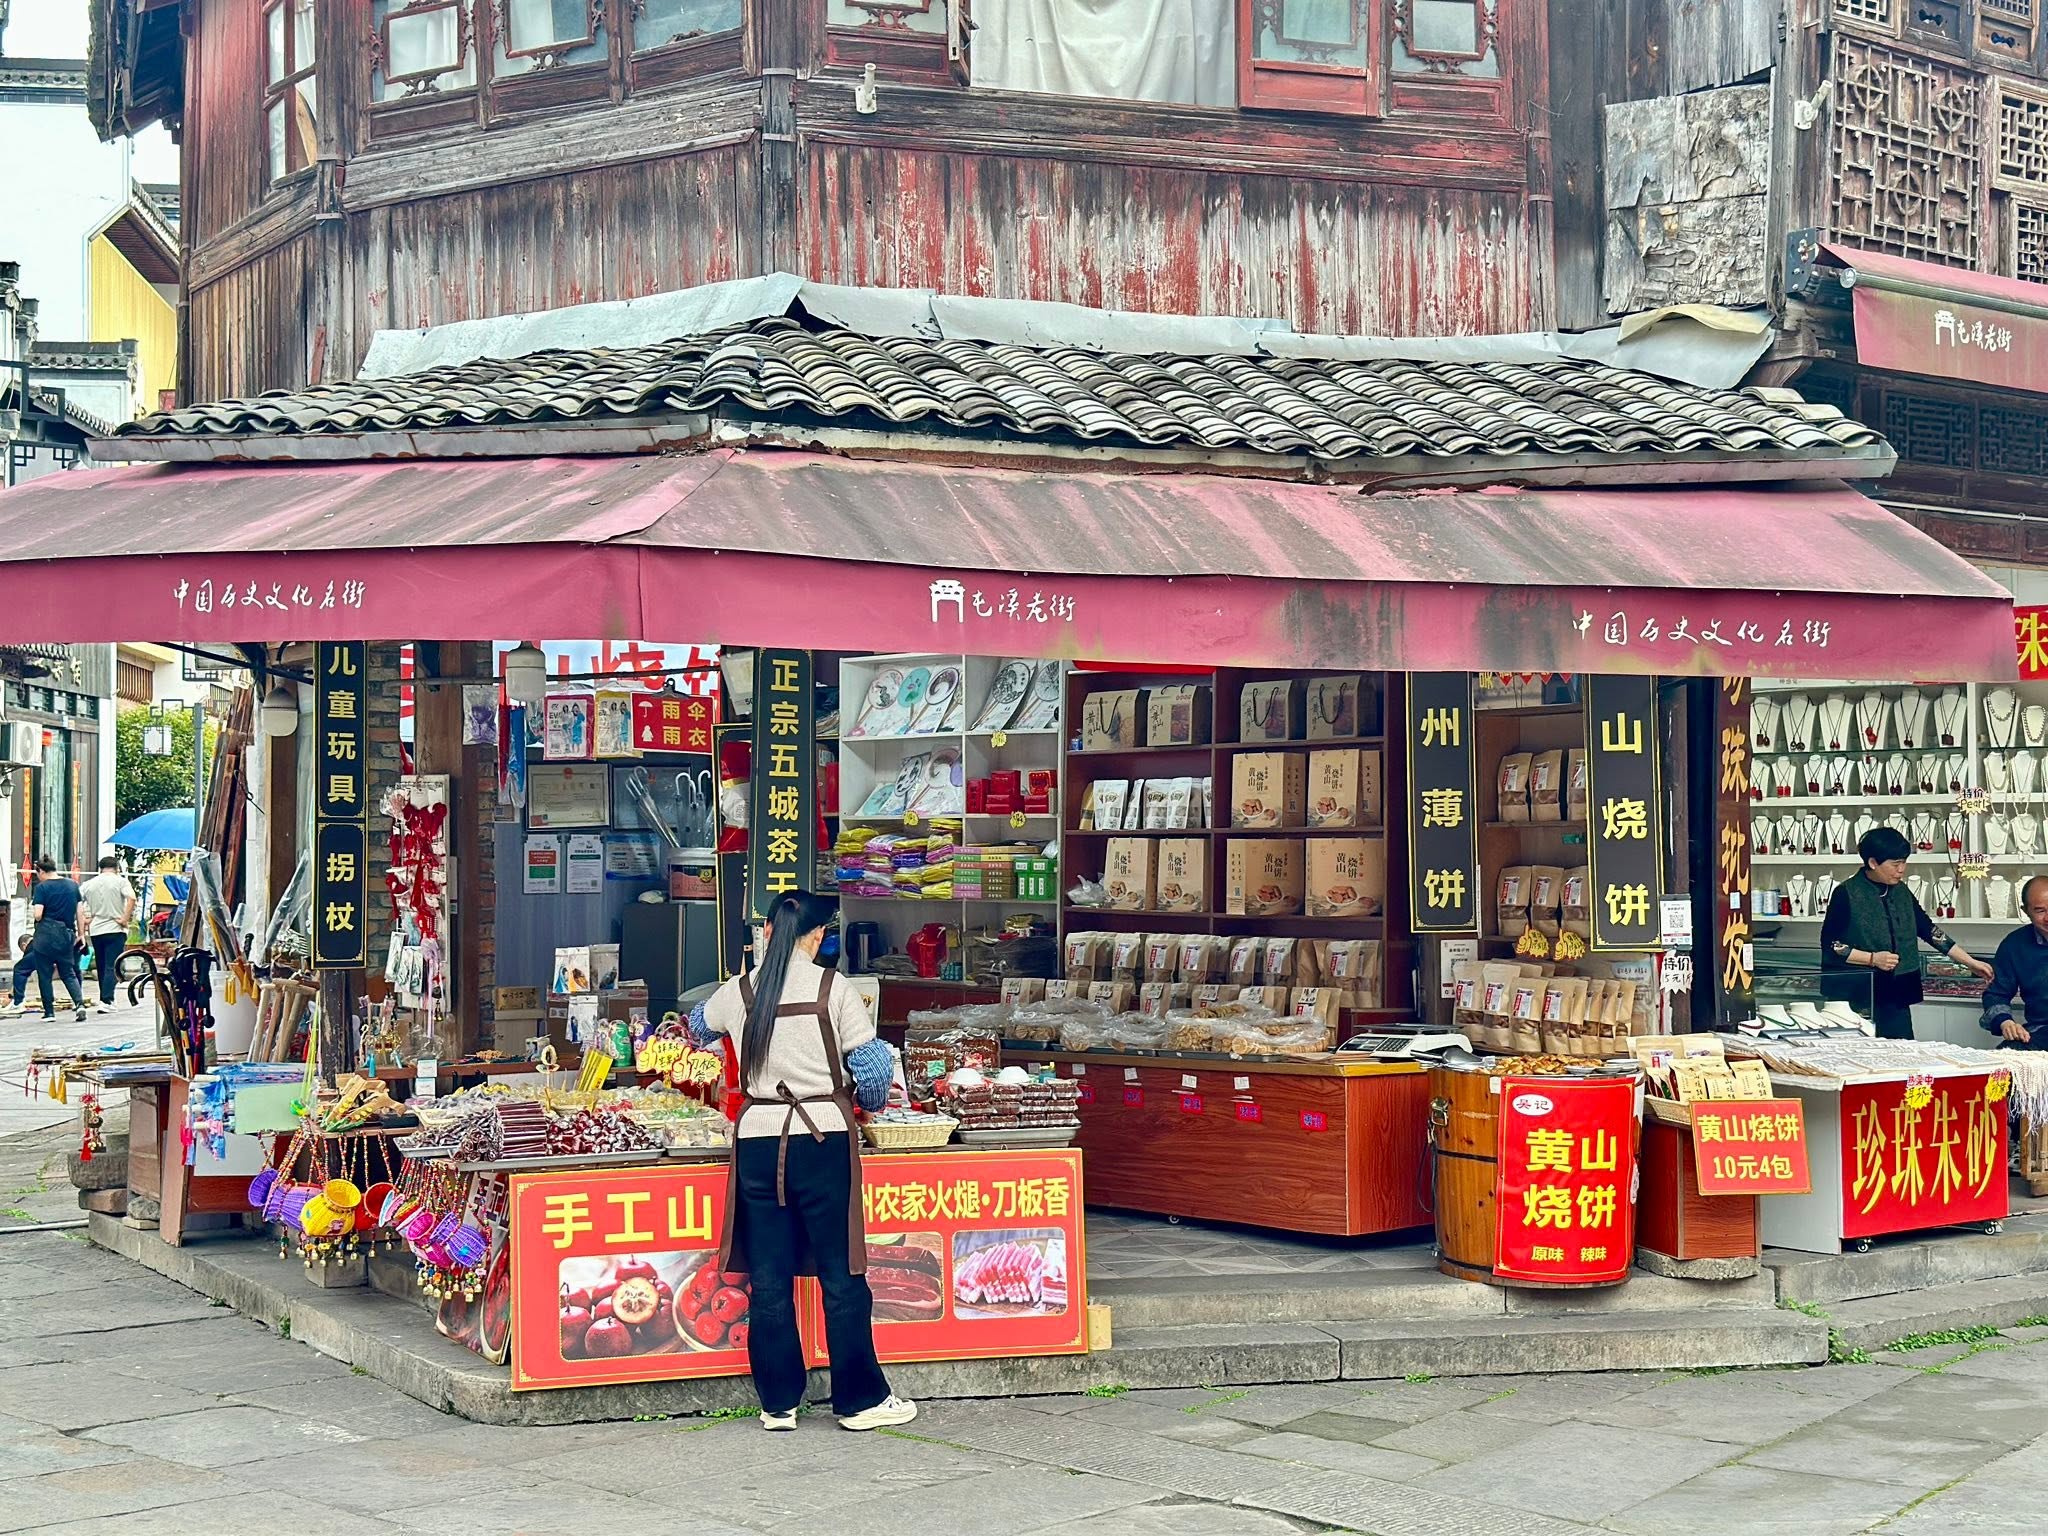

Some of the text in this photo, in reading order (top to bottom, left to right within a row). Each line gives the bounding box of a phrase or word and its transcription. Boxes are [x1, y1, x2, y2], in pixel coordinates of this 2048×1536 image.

[1957, 320, 2013, 353] 屯溪老街
[173, 578, 366, 613] 中国历史文化名街
[972, 587, 1076, 623] 屯溪老街
[1572, 609, 1832, 648] 中国历史文化名街
[326, 646, 357, 804] 儿童玩具
[662, 700, 706, 722] 雨伞
[663, 725, 707, 746] 雨衣
[1420, 707, 1466, 909] 州薄饼
[1602, 712, 1651, 927] 山烧饼
[1960, 798, 1986, 809] Pearl
[326, 852, 356, 932] 拐杖
[1697, 1114, 1800, 1143] 黄山烧饼
[1525, 1128, 1617, 1173] 黄山
[1713, 1154, 1794, 1180] 10元4包
[1851, 1089, 1998, 1215] 珍珠朱砂
[542, 1185, 713, 1250] 手工山
[1522, 1183, 1617, 1230] 烧饼
[1531, 1246, 1607, 1262] 原味 辣味
